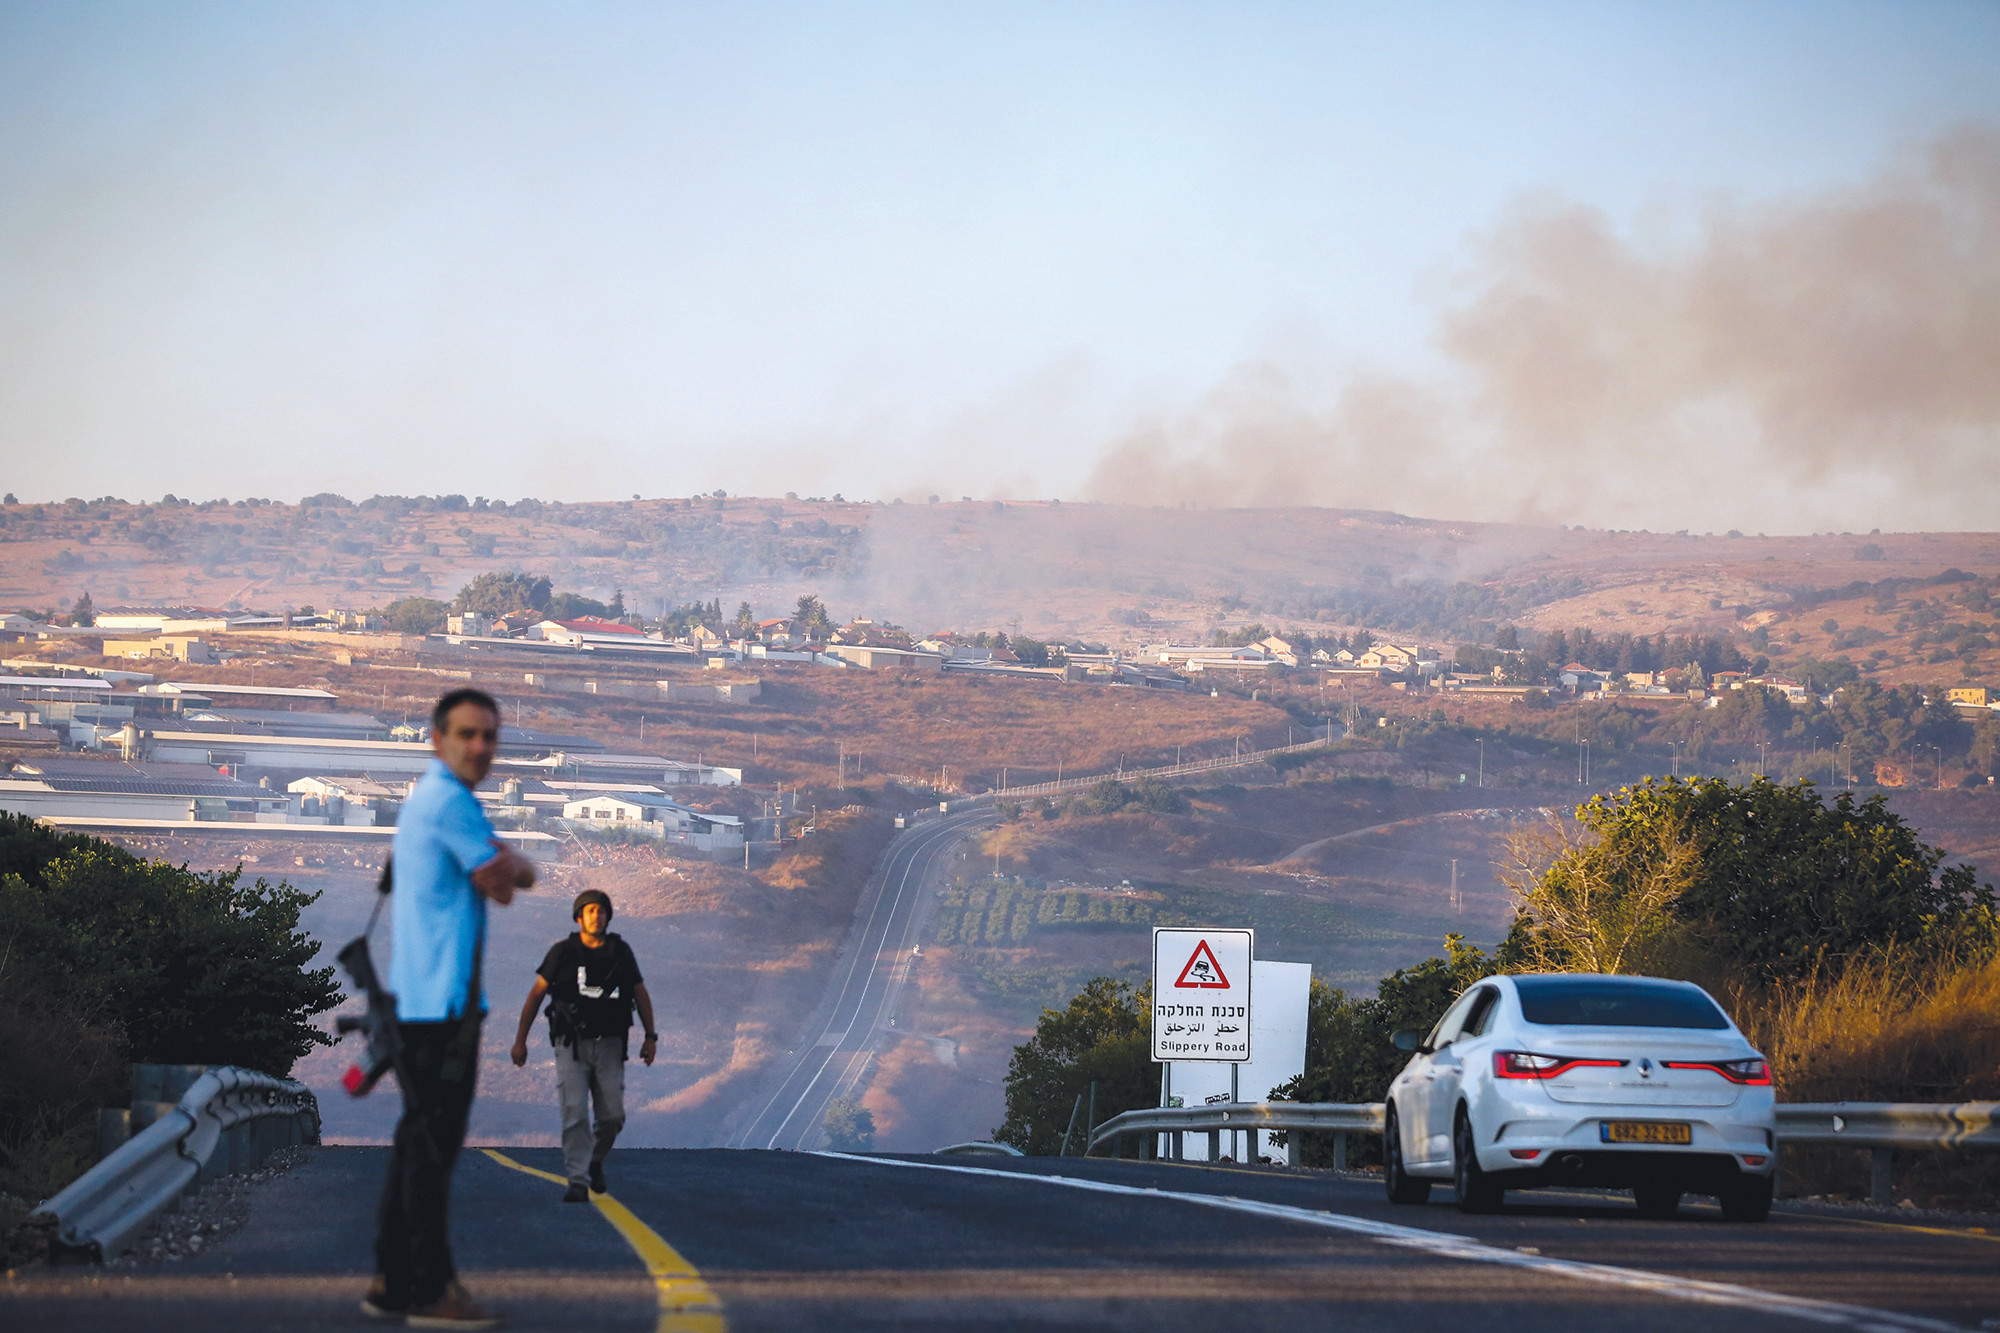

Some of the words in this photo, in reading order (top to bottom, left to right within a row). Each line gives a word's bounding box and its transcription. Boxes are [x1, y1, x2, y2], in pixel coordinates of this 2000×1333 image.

[1158, 1004, 1203, 1018] החלקה
[1211, 1006, 1245, 1017] סכנת
[1164, 1023, 1205, 1036] التزحلق
[1214, 1023, 1240, 1037] خطر
[1161, 1041, 1209, 1053] Slippery
[1215, 1042, 1246, 1051] Road
